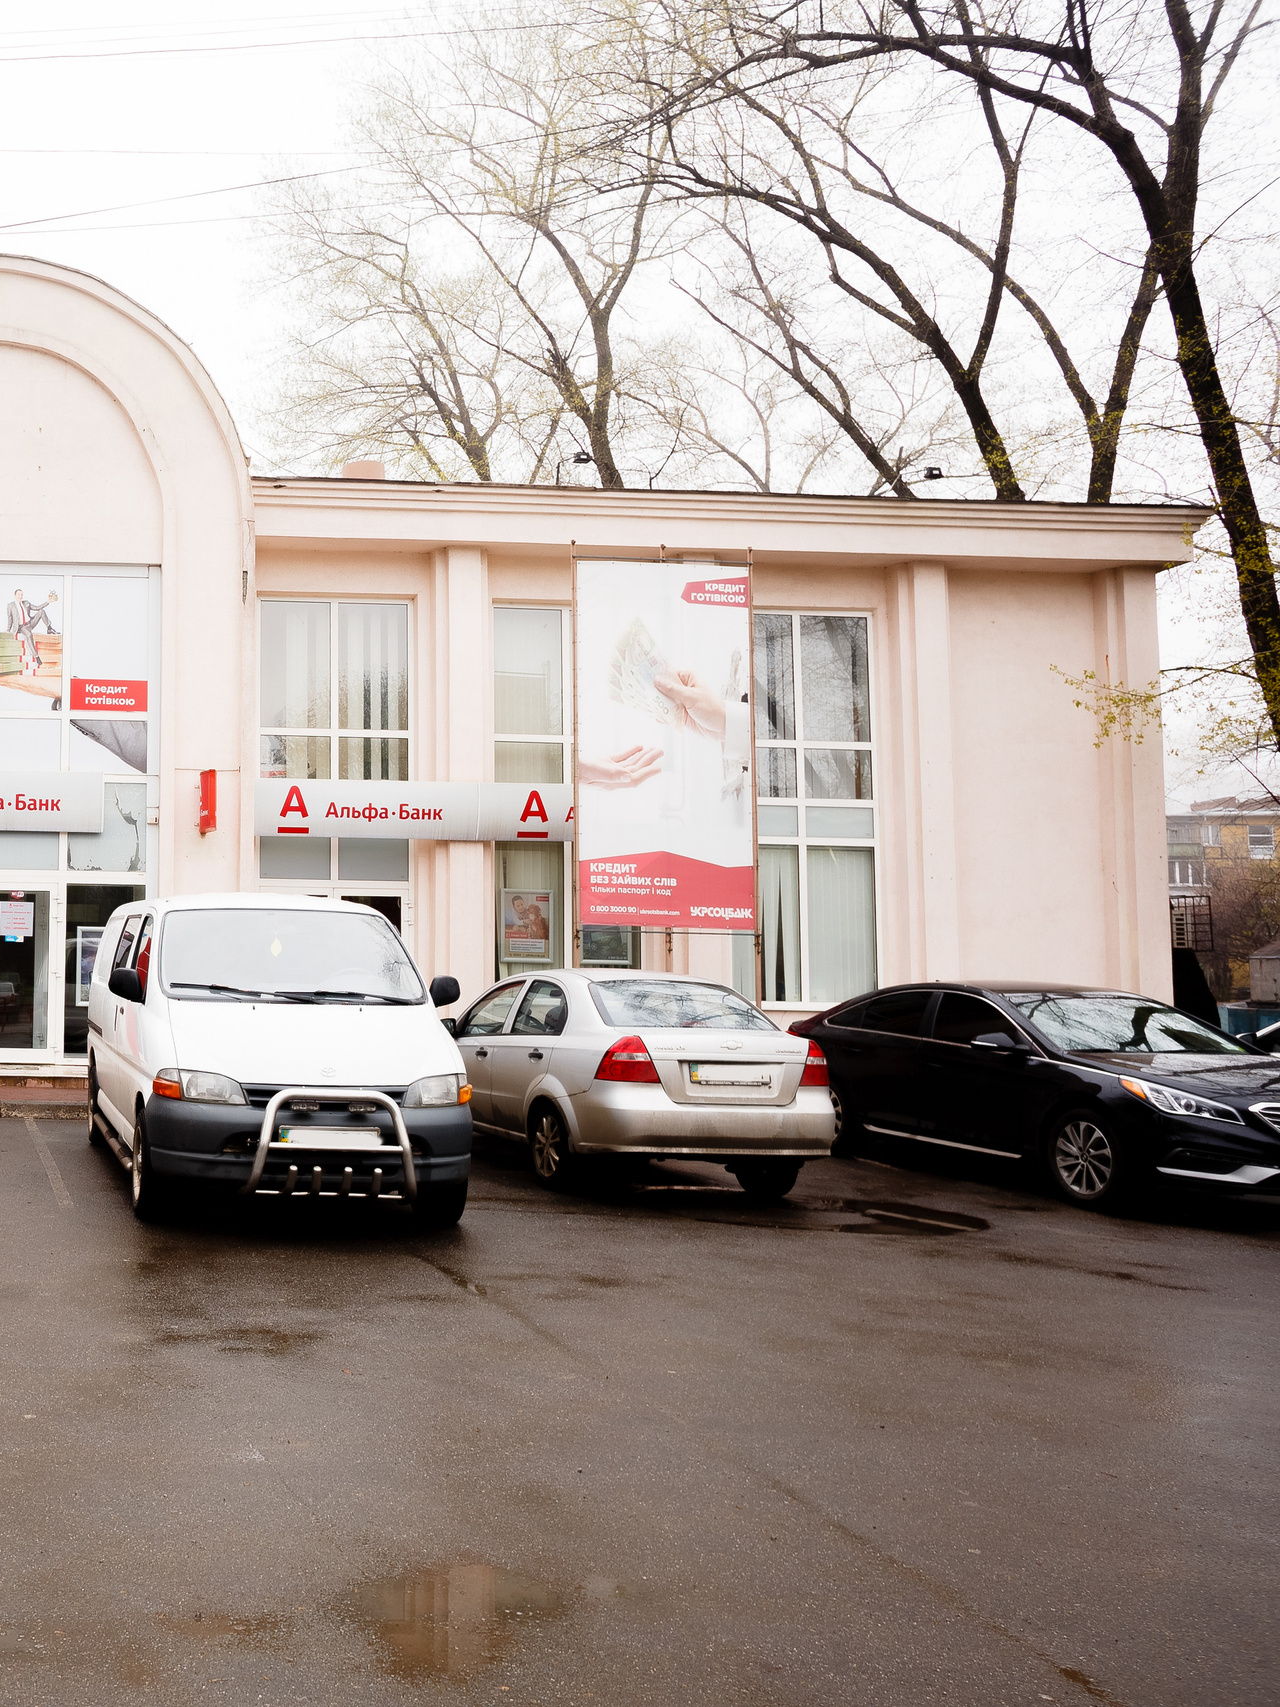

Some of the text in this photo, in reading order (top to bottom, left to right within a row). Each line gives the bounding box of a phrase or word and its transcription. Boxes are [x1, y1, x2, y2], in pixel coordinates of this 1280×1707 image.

[705, 583, 745, 593] КРЕДИТ
[691, 592, 746, 604] ГОТІВКОЮ
[85, 683, 128, 695] Кредит
[85, 695, 136, 706] готівкою
[590, 862, 637, 874] КРЕДИТ
[590, 874, 677, 887] БЕЗ ЗАЙВИХ СЛІВ
[591, 885, 616, 893] тільки
[617, 886, 650, 896] паспорт
[690, 906, 753, 920] УКРСОЦБАНК
